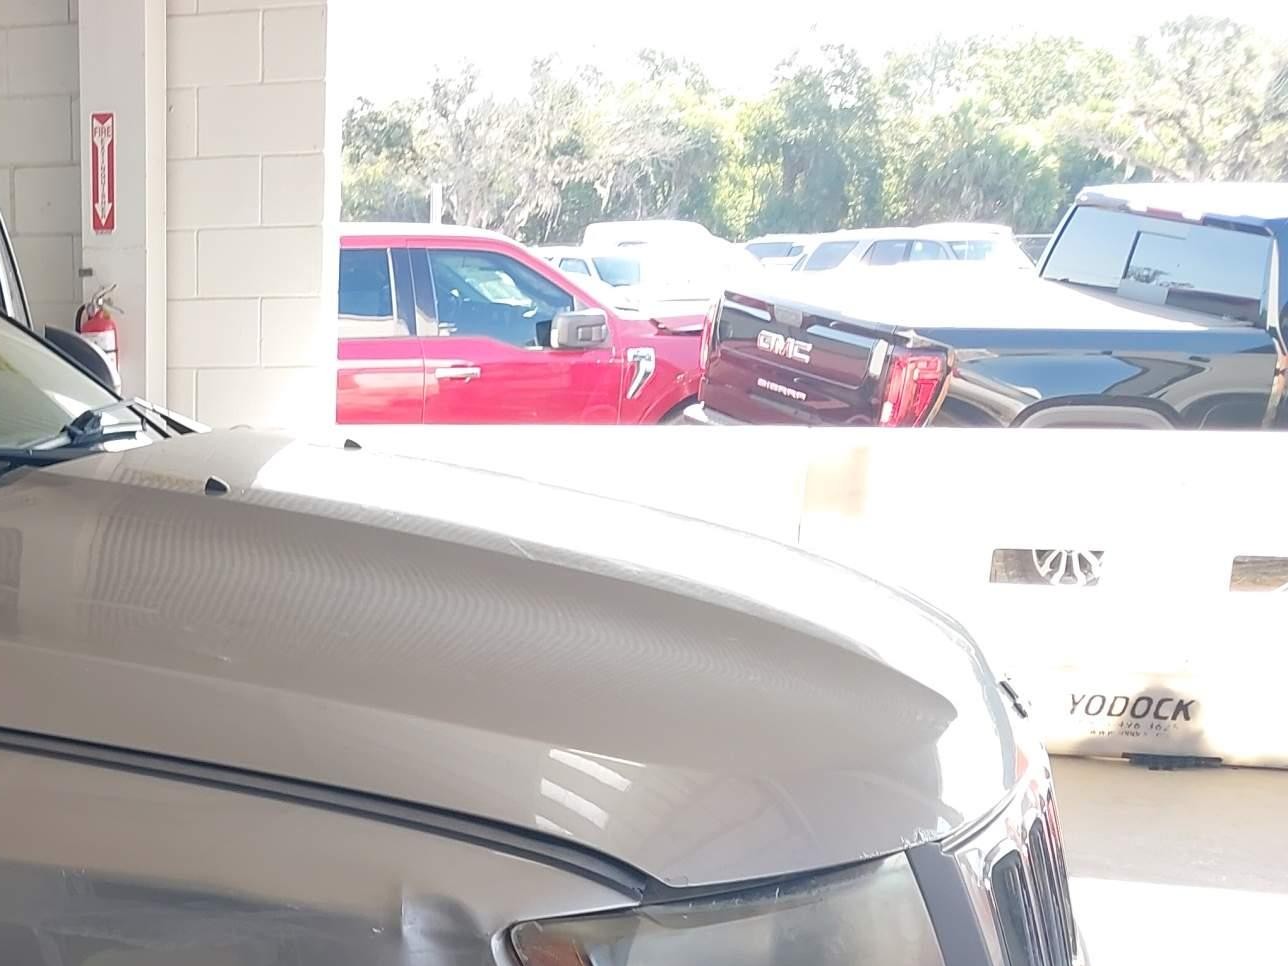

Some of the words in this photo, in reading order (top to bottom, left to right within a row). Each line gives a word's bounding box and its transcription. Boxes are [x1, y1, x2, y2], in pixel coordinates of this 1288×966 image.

[93, 127, 112, 138] FIRE
[757, 329, 813, 364] GMC
[757, 377, 807, 401] SIERRA
[1069, 693, 1196, 721] YODOCK
